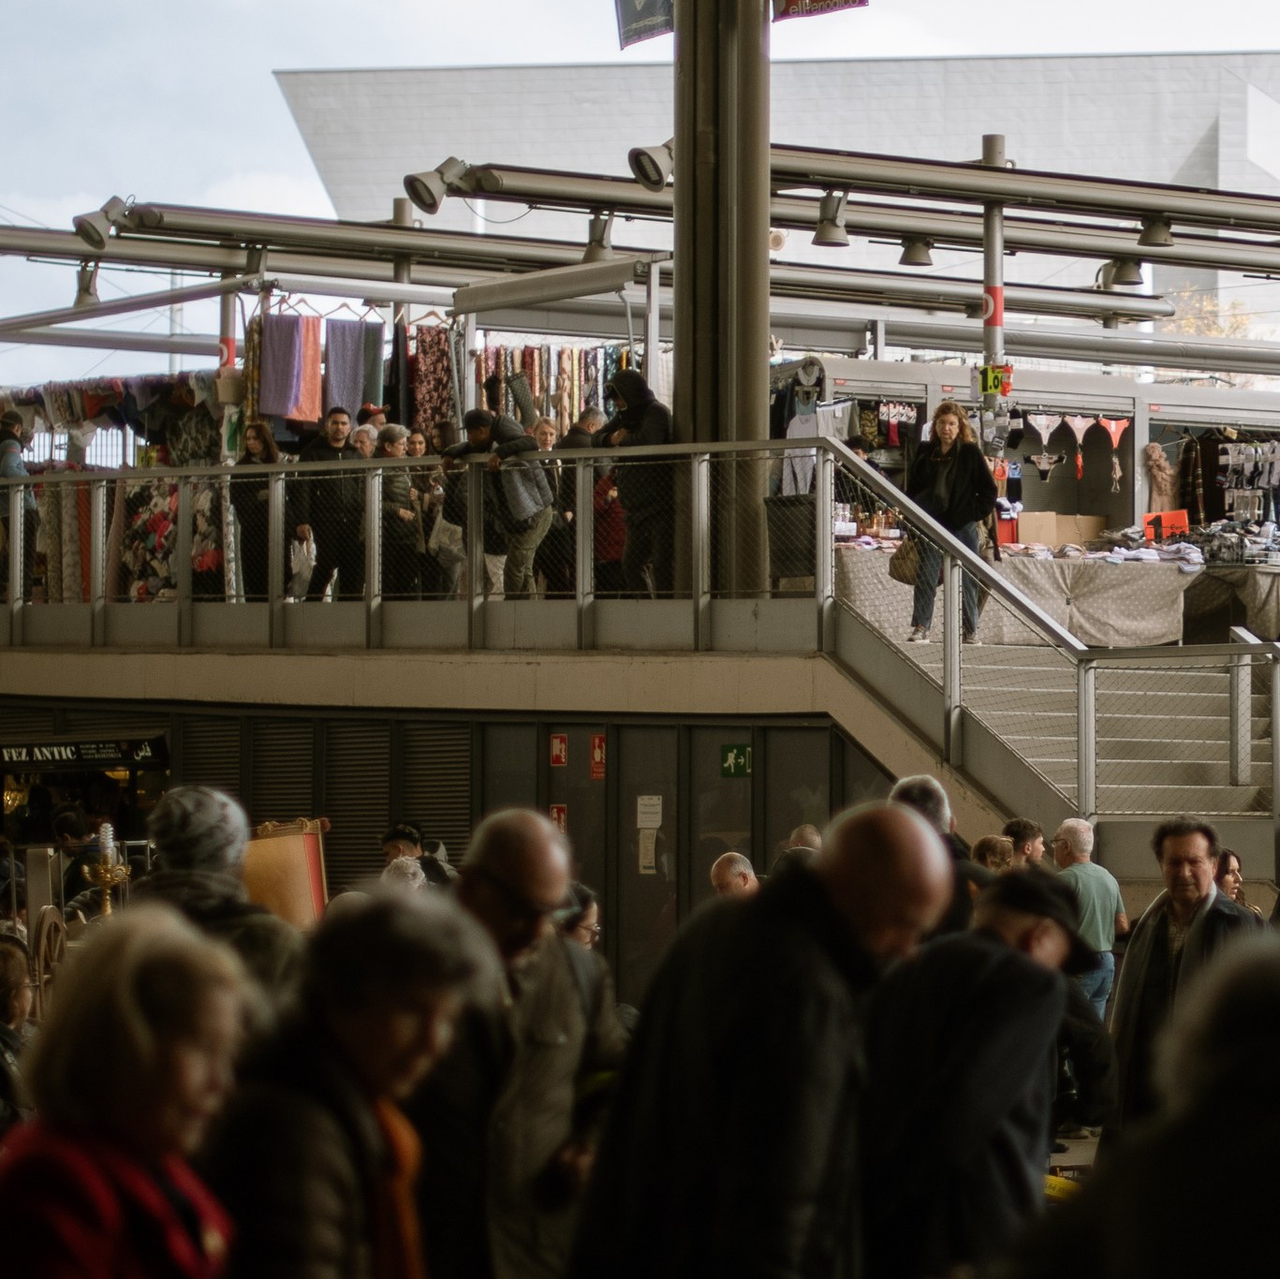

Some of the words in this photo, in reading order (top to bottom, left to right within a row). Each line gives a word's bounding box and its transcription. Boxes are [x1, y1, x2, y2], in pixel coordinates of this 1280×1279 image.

[979, 367, 1003, 393] 1.0
[1147, 515, 1163, 542] 1
[2, 747, 29, 762] FEZ
[33, 745, 77, 761] ANTIC
